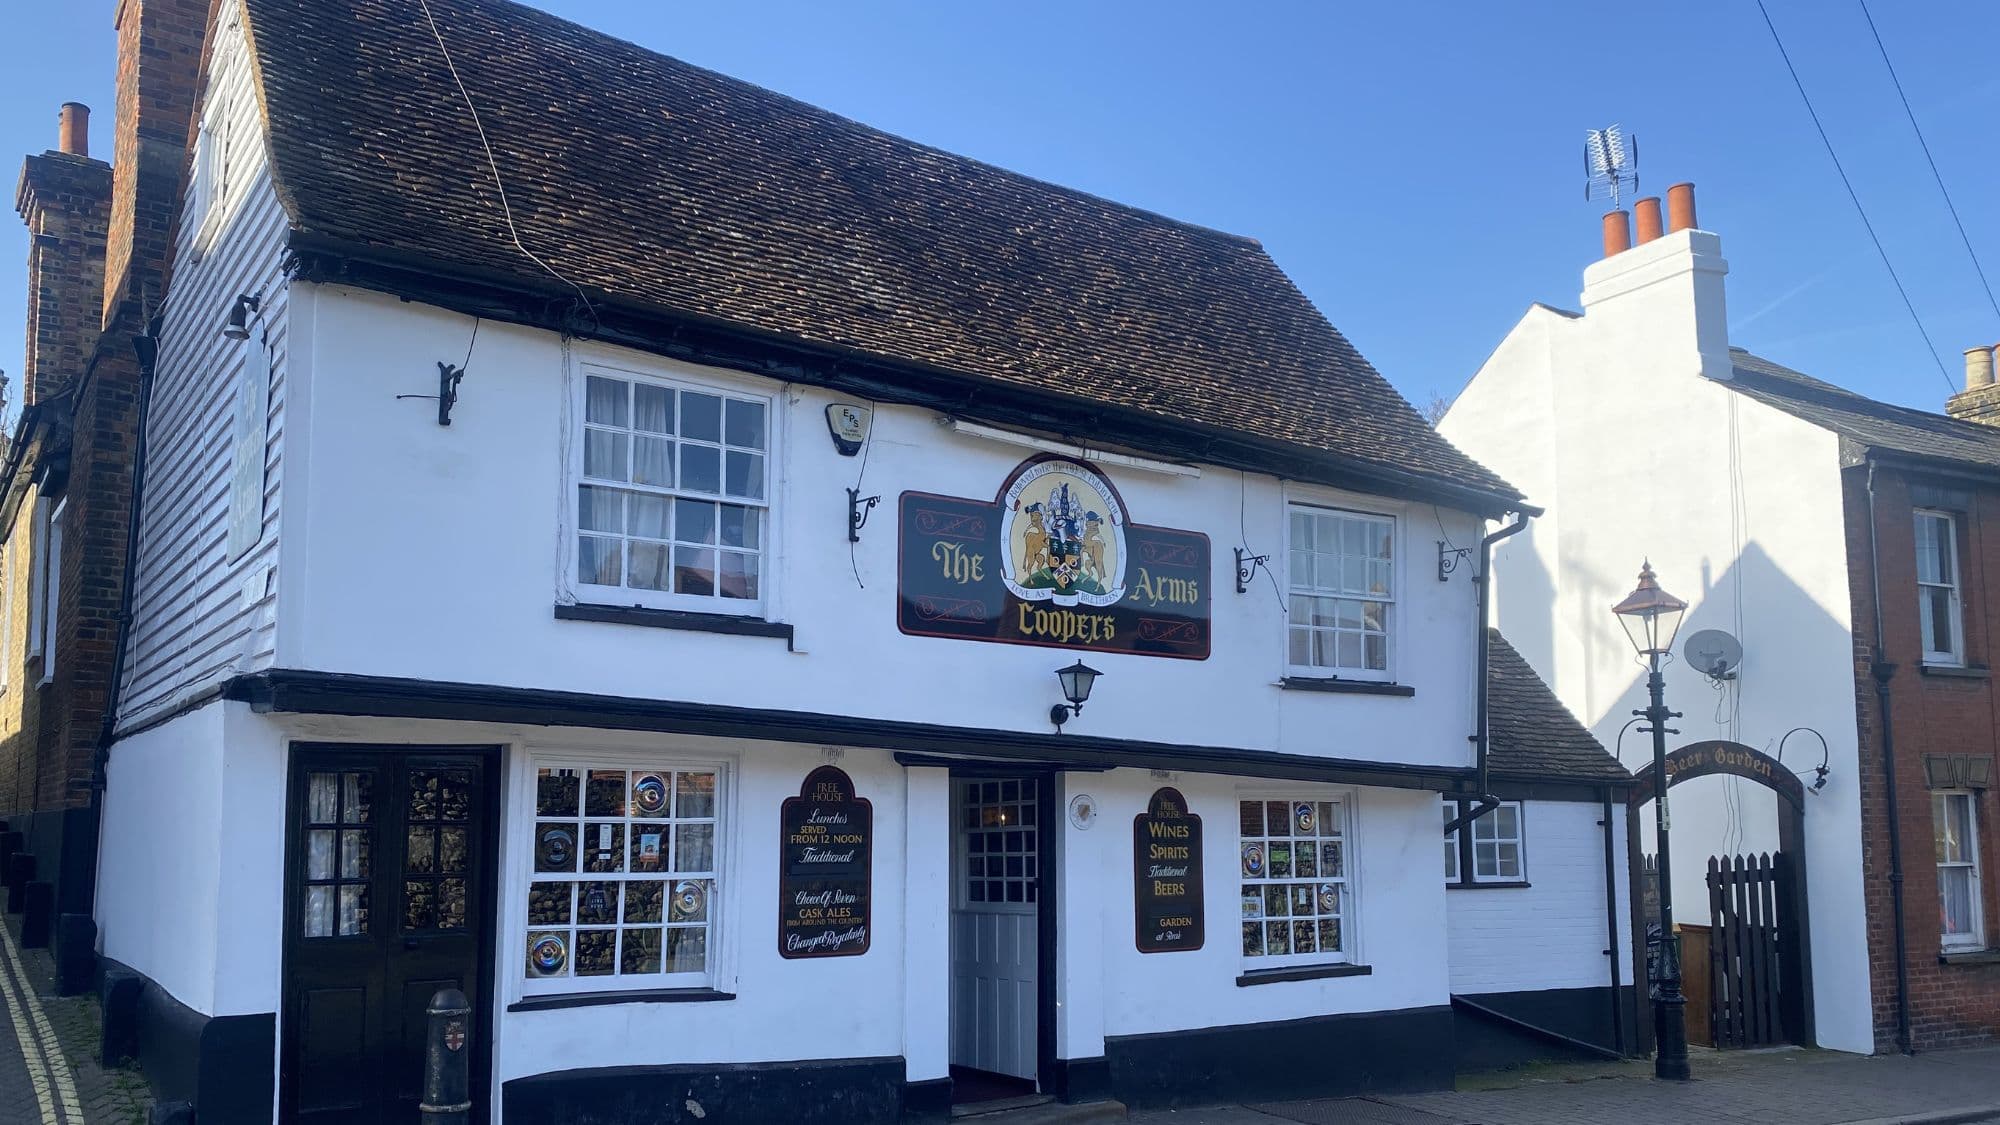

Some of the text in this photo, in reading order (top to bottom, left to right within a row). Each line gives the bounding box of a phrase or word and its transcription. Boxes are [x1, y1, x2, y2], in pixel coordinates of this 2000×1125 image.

[843, 409, 859, 427] EPS
[932, 541, 984, 584] The
[1010, 584, 1030, 598] LOVE
[1130, 568, 1198, 607] Arms
[1081, 592, 1120, 603] BRETHREN
[1018, 602, 1115, 644] Coopers
[1665, 747, 1772, 776] Beer Garden
[817, 783, 838, 793] FREE
[812, 792, 843, 802] HOUSE
[1161, 801, 1176, 811] FREE
[1157, 810, 1181, 818] HOUSE
[800, 826, 826, 834] SERVED
[1149, 822, 1189, 838] WINES
[791, 835, 862, 844] FROM 12 NOON
[799, 848, 854, 863] Traditional
[1150, 844, 1189, 859] SPIRITS
[1147, 865, 1187, 878] Traditional
[1154, 881, 1185, 896] BEERS
[794, 888, 856, 908] Choice Of Seven
[799, 908, 851, 918] CASK ALES
[787, 916, 863, 926] FROM AROUND THE COUNTRY
[1160, 917, 1192, 926] GARDEN
[787, 926, 865, 952] Changed Regularly
[1156, 932, 1164, 941] at
